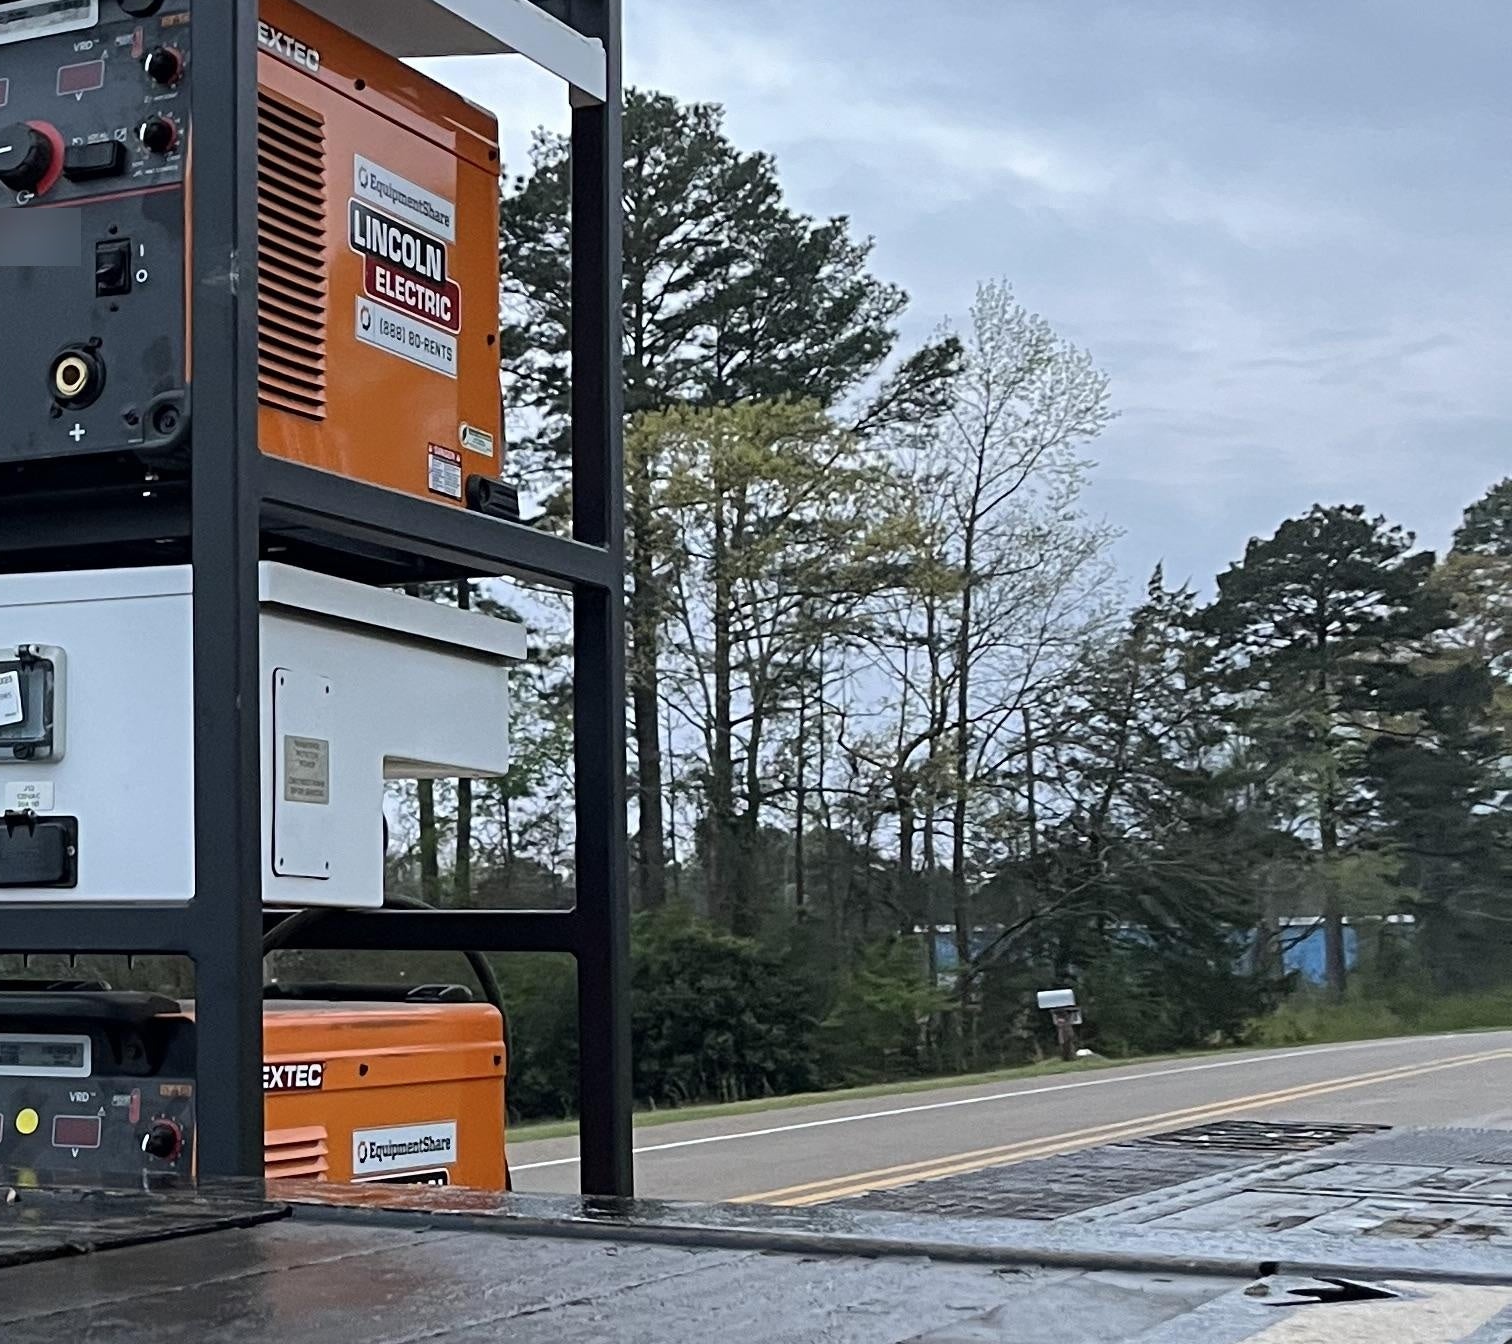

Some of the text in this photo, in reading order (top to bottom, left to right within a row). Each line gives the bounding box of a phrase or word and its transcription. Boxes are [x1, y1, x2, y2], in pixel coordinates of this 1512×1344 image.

[370, 173, 450, 229] EquipmentShare
[354, 209, 442, 282] LINCOLN
[375, 265, 451, 323] ELECTRIC
[379, 317, 406, 344] (888)
[69, 1091, 90, 1103] VRD
[370, 1135, 451, 1162] EquipmentShare
